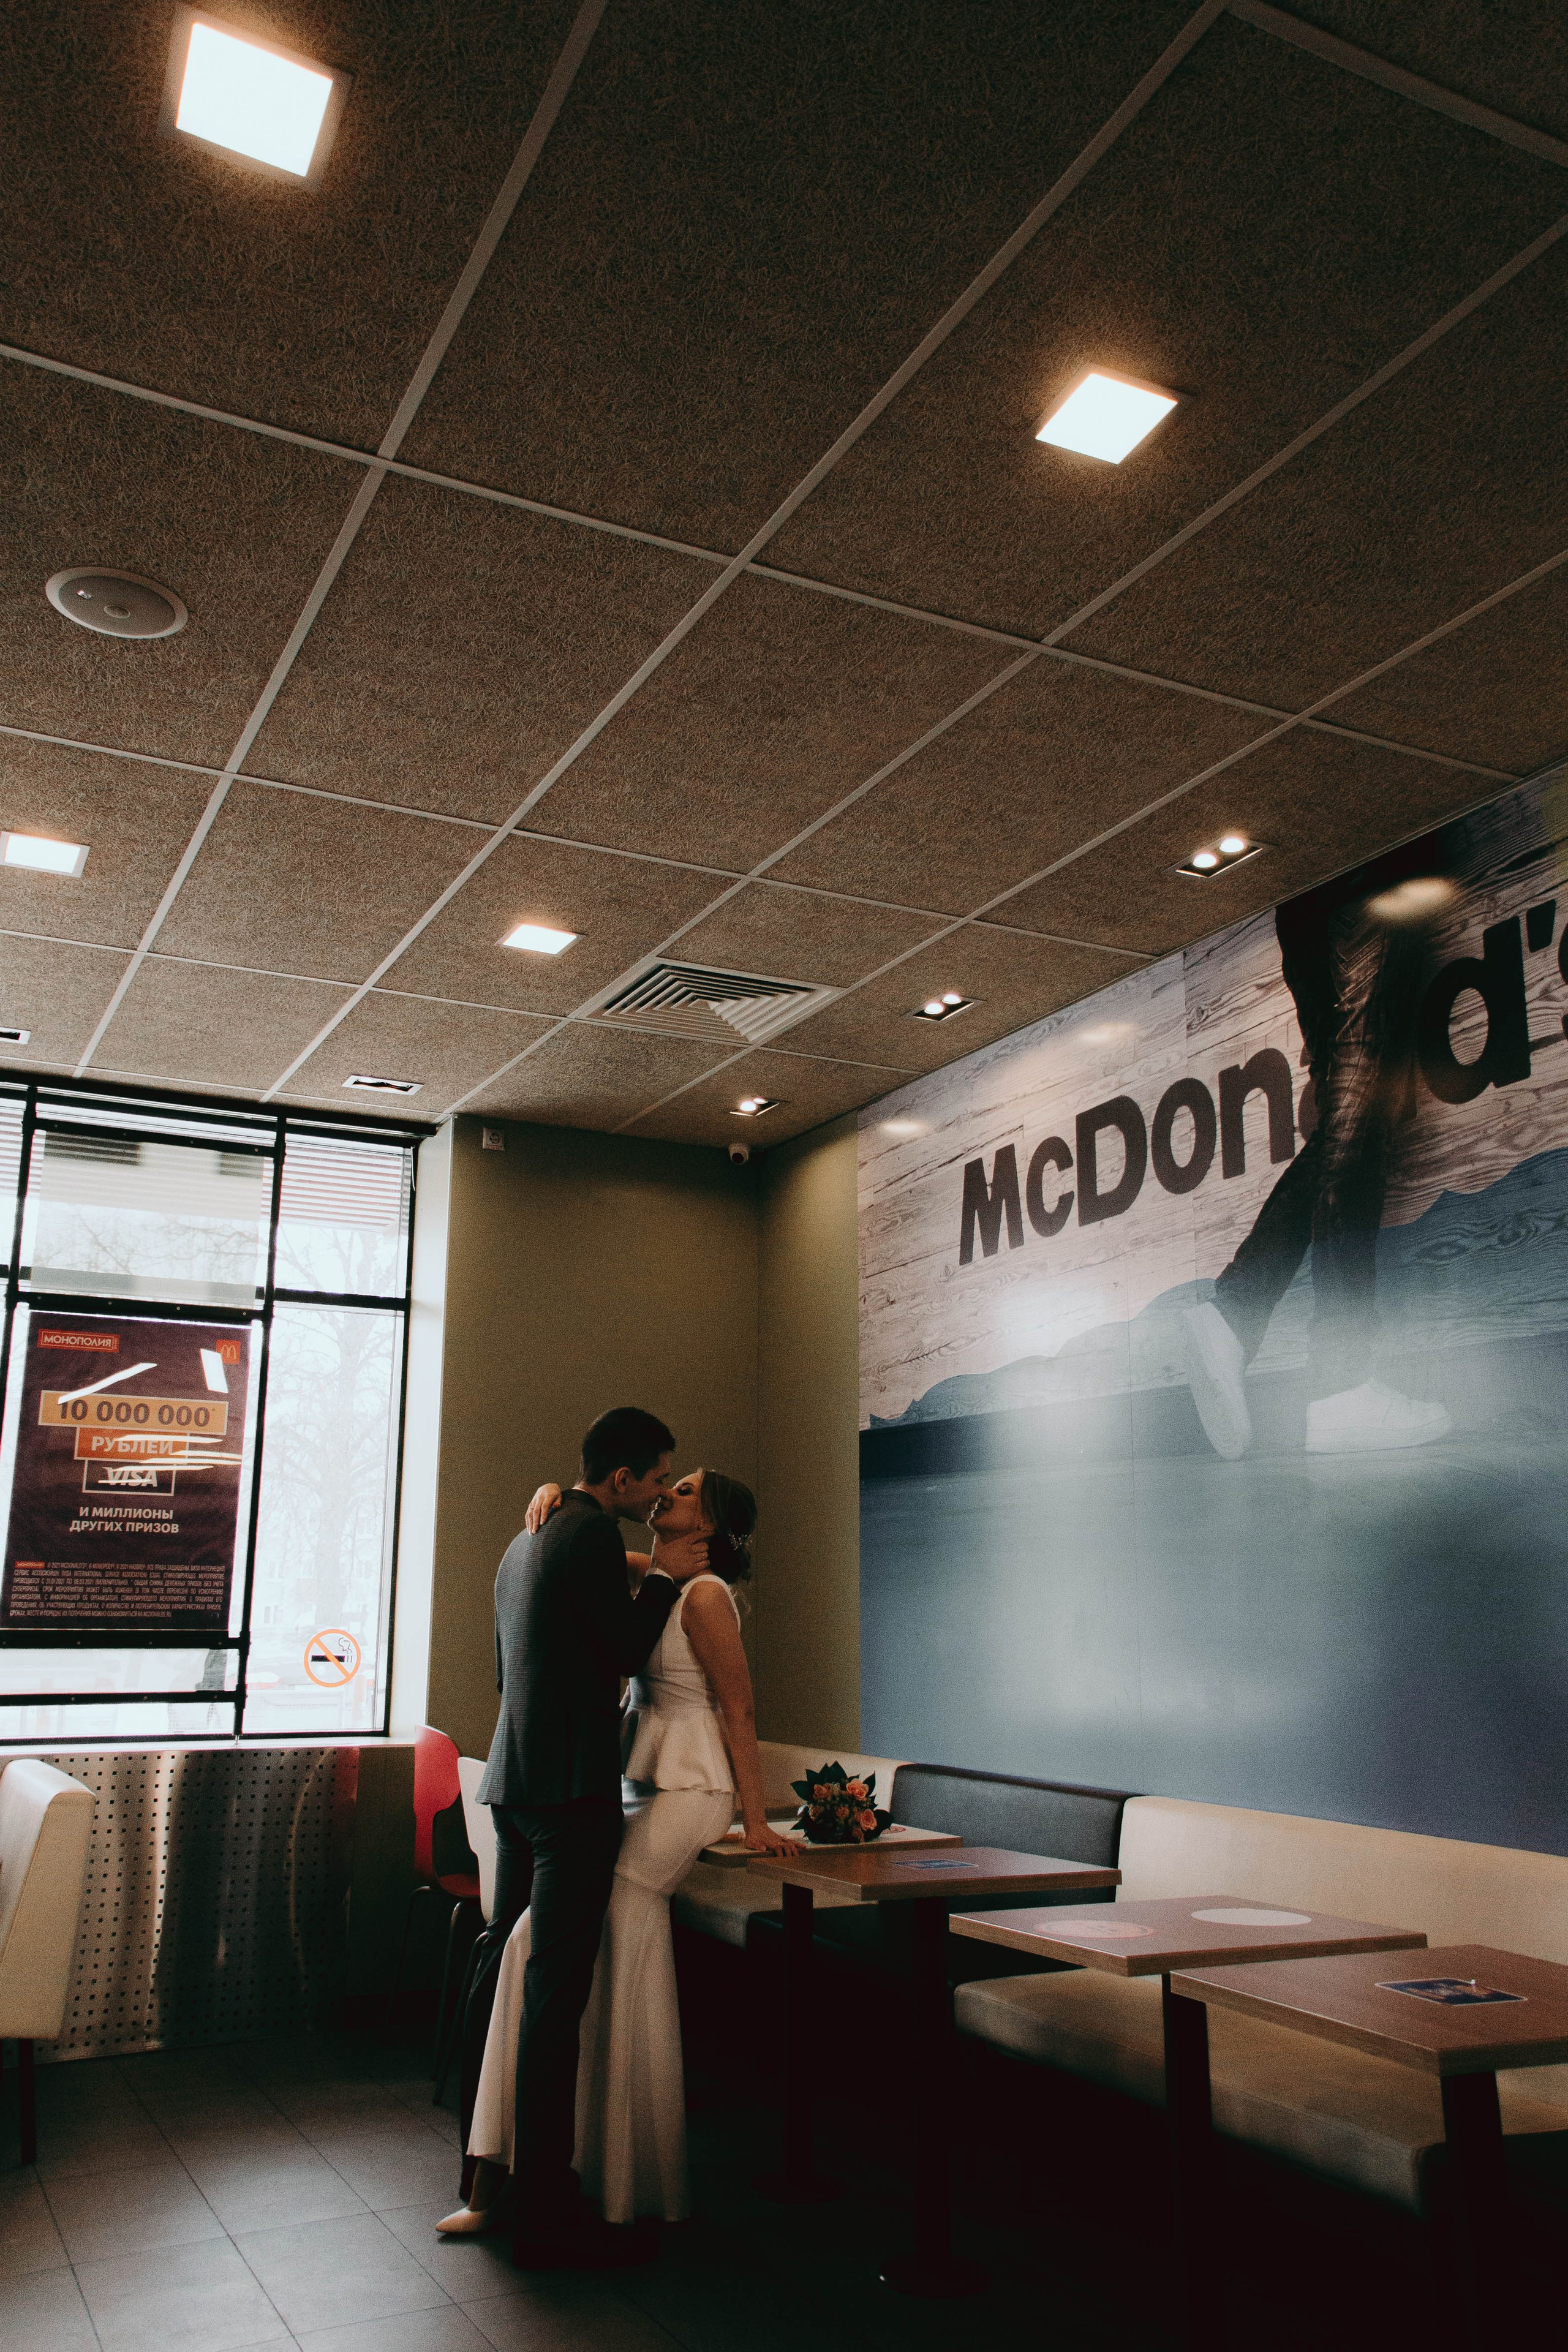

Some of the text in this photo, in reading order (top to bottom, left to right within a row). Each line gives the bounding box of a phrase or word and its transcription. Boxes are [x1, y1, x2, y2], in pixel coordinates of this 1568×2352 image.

[43, 1335, 111, 1347] МОНОПОЛИЯ
[58, 1399, 88, 1420] 10
[96, 1401, 150, 1424] 000
[103, 1466, 158, 1488] VISA
[79, 1506, 173, 1520] И МИЛЛИОНЫ
[69, 1520, 179, 1534] ДРУГИХ ПРИЗОВ
